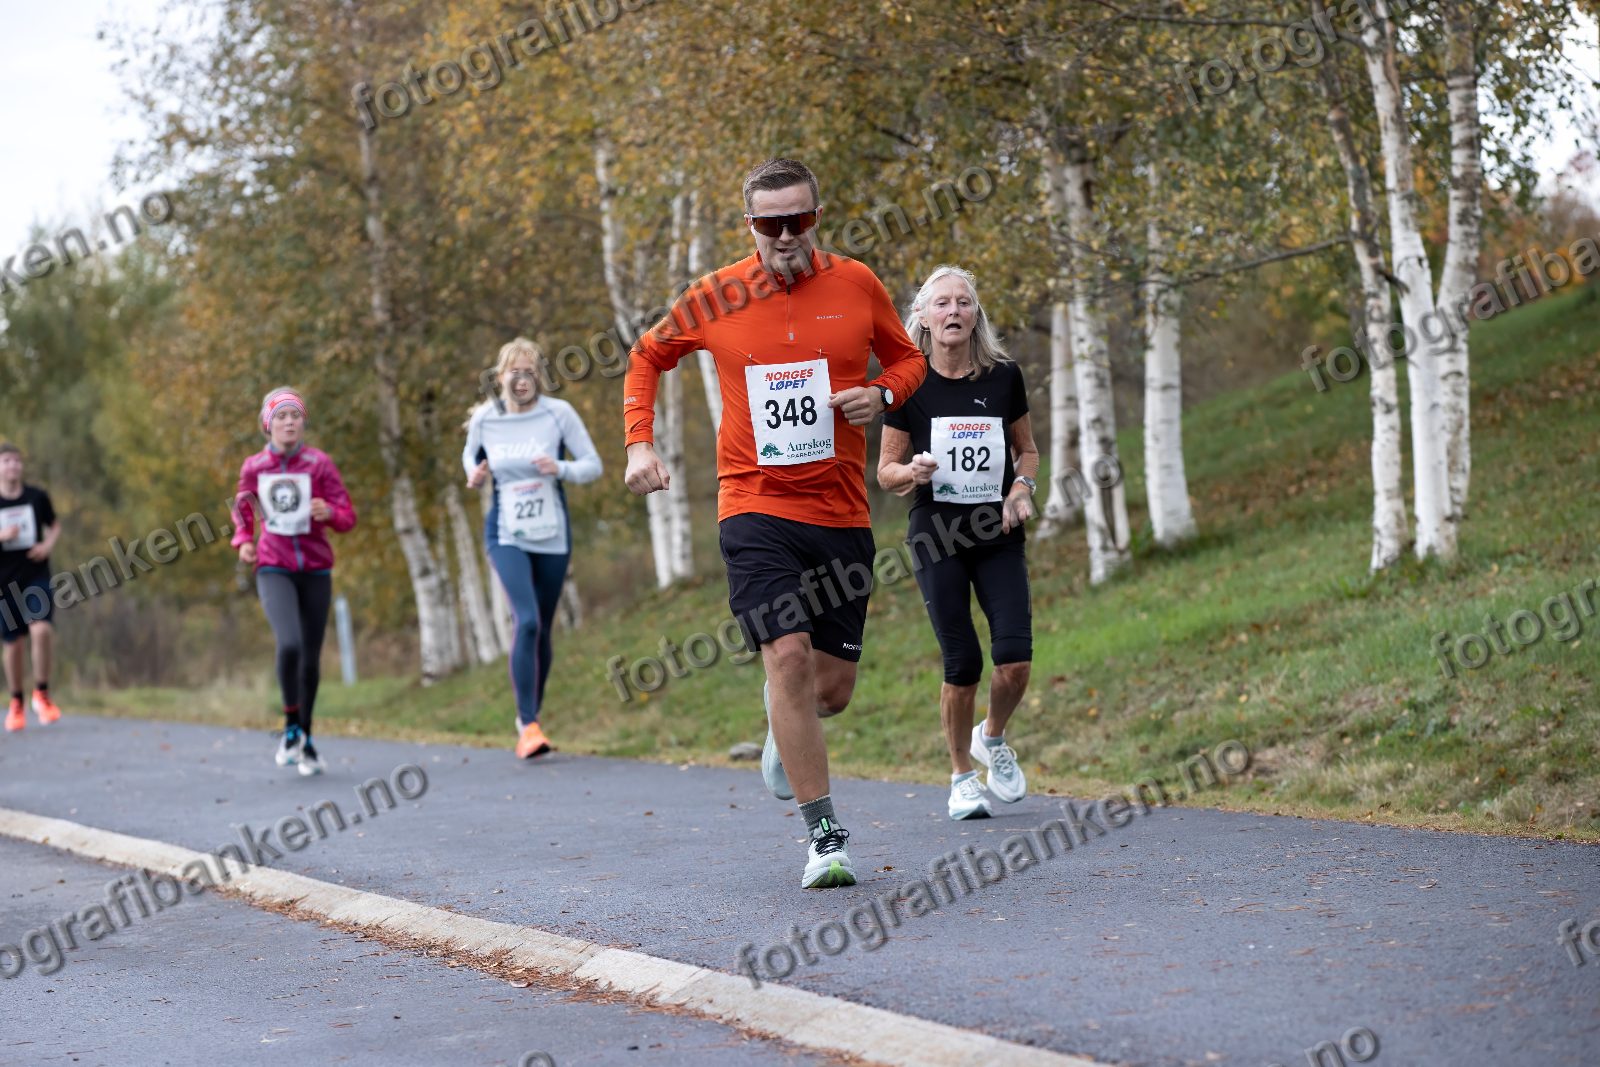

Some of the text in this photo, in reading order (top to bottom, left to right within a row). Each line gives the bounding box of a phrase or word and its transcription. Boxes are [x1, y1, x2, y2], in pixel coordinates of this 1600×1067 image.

[765, 368, 814, 382] NORGES
[769, 378, 808, 391] LØPET
[765, 395, 818, 430] 348
[949, 423, 991, 431] NORGES
[952, 431, 985, 439] LØPET
[787, 438, 832, 452] Aurskog
[947, 446, 991, 472] 182
[962, 482, 999, 493] Aurskog
[514, 498, 544, 519] 227
